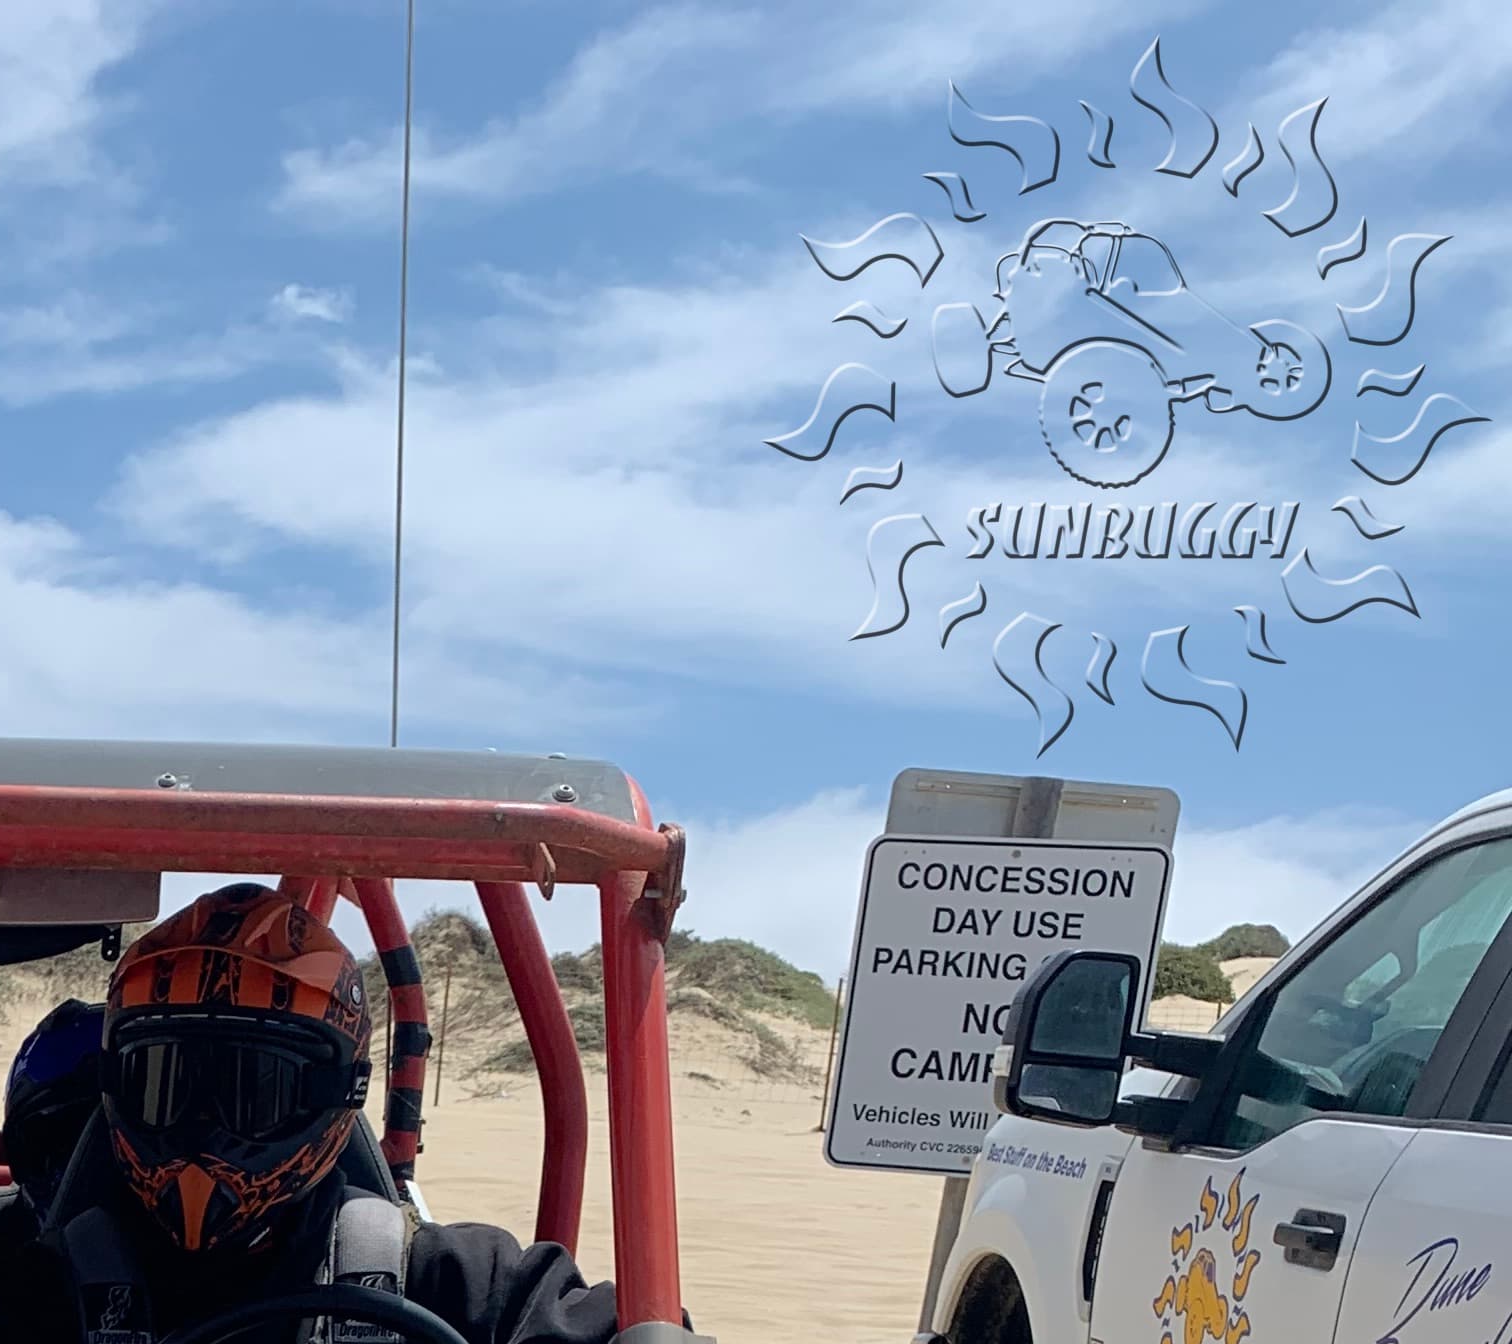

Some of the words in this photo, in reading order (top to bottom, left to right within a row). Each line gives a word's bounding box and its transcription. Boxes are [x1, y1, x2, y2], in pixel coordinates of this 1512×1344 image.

[897, 861, 1136, 898] CONCESSION
[932, 907, 1003, 937] DAY
[1012, 910, 1085, 940] USE
[872, 947, 1027, 981] PARKING
[853, 1103, 941, 1127] Vehicles
[949, 1110, 989, 1131] Will
[866, 1137, 917, 1153] Authority
[919, 1141, 944, 1153] CVC
[1035, 1151, 1054, 1173] the
[1054, 1154, 1087, 1179] Beach
